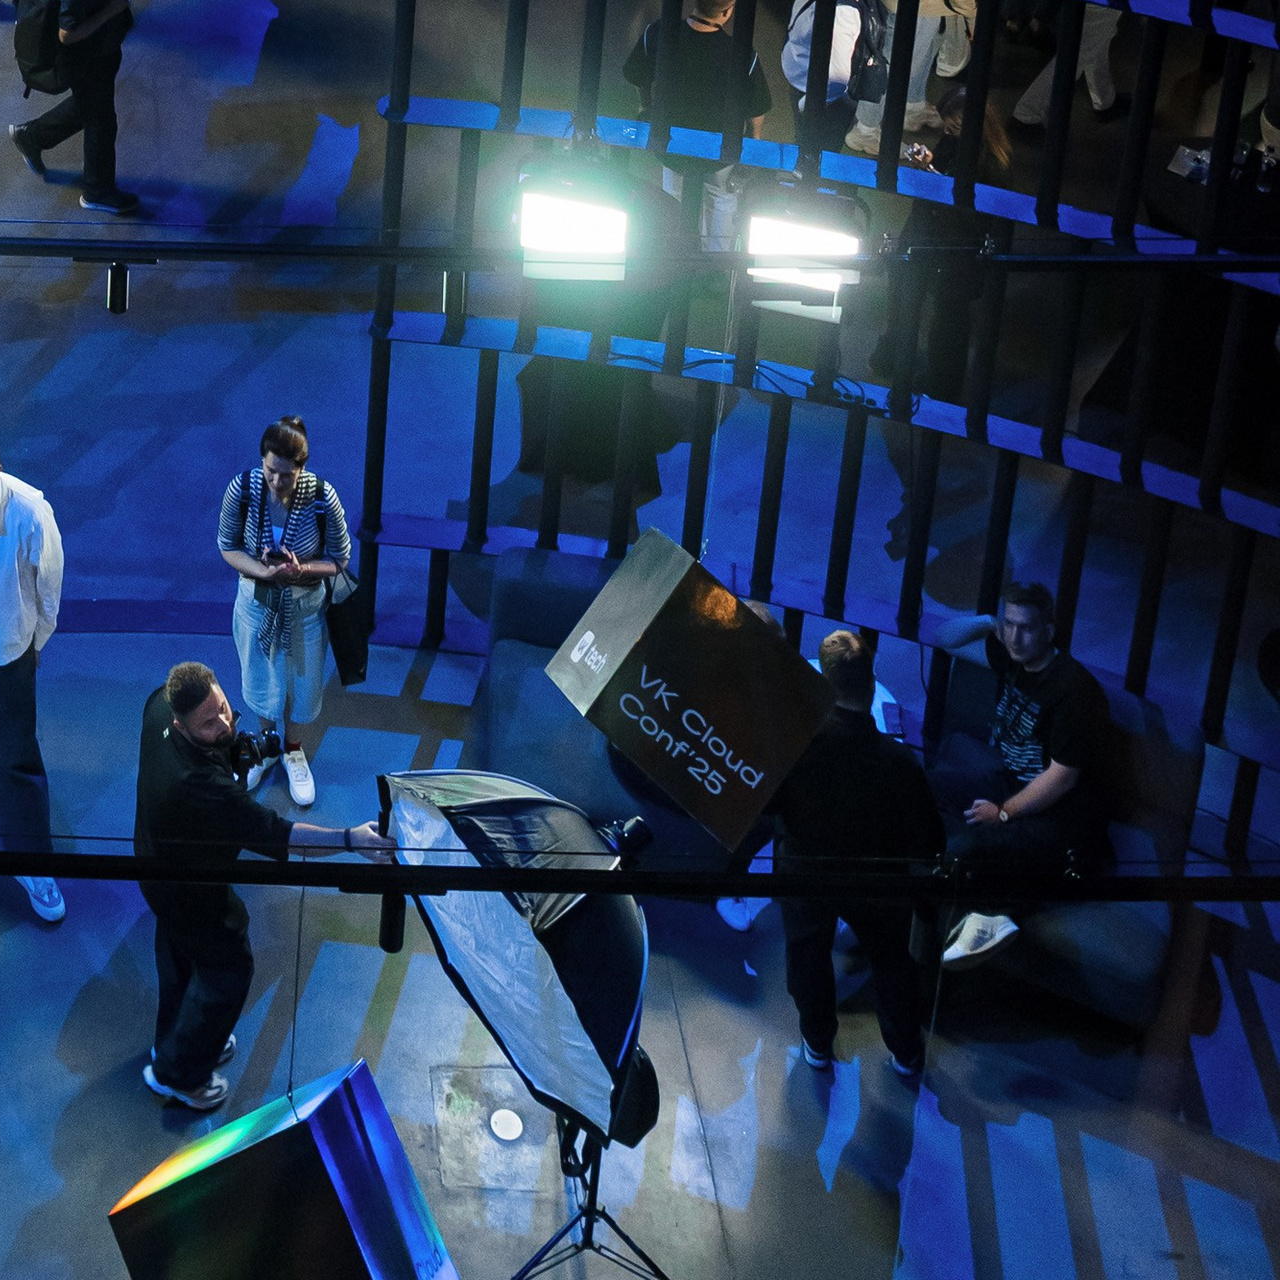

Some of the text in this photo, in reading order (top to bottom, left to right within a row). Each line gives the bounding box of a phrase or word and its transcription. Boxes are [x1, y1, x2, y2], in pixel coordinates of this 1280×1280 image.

[584, 643, 608, 675] tech
[619, 692, 728, 796] Conf'25
[640, 664, 765, 790] VK Cloud
